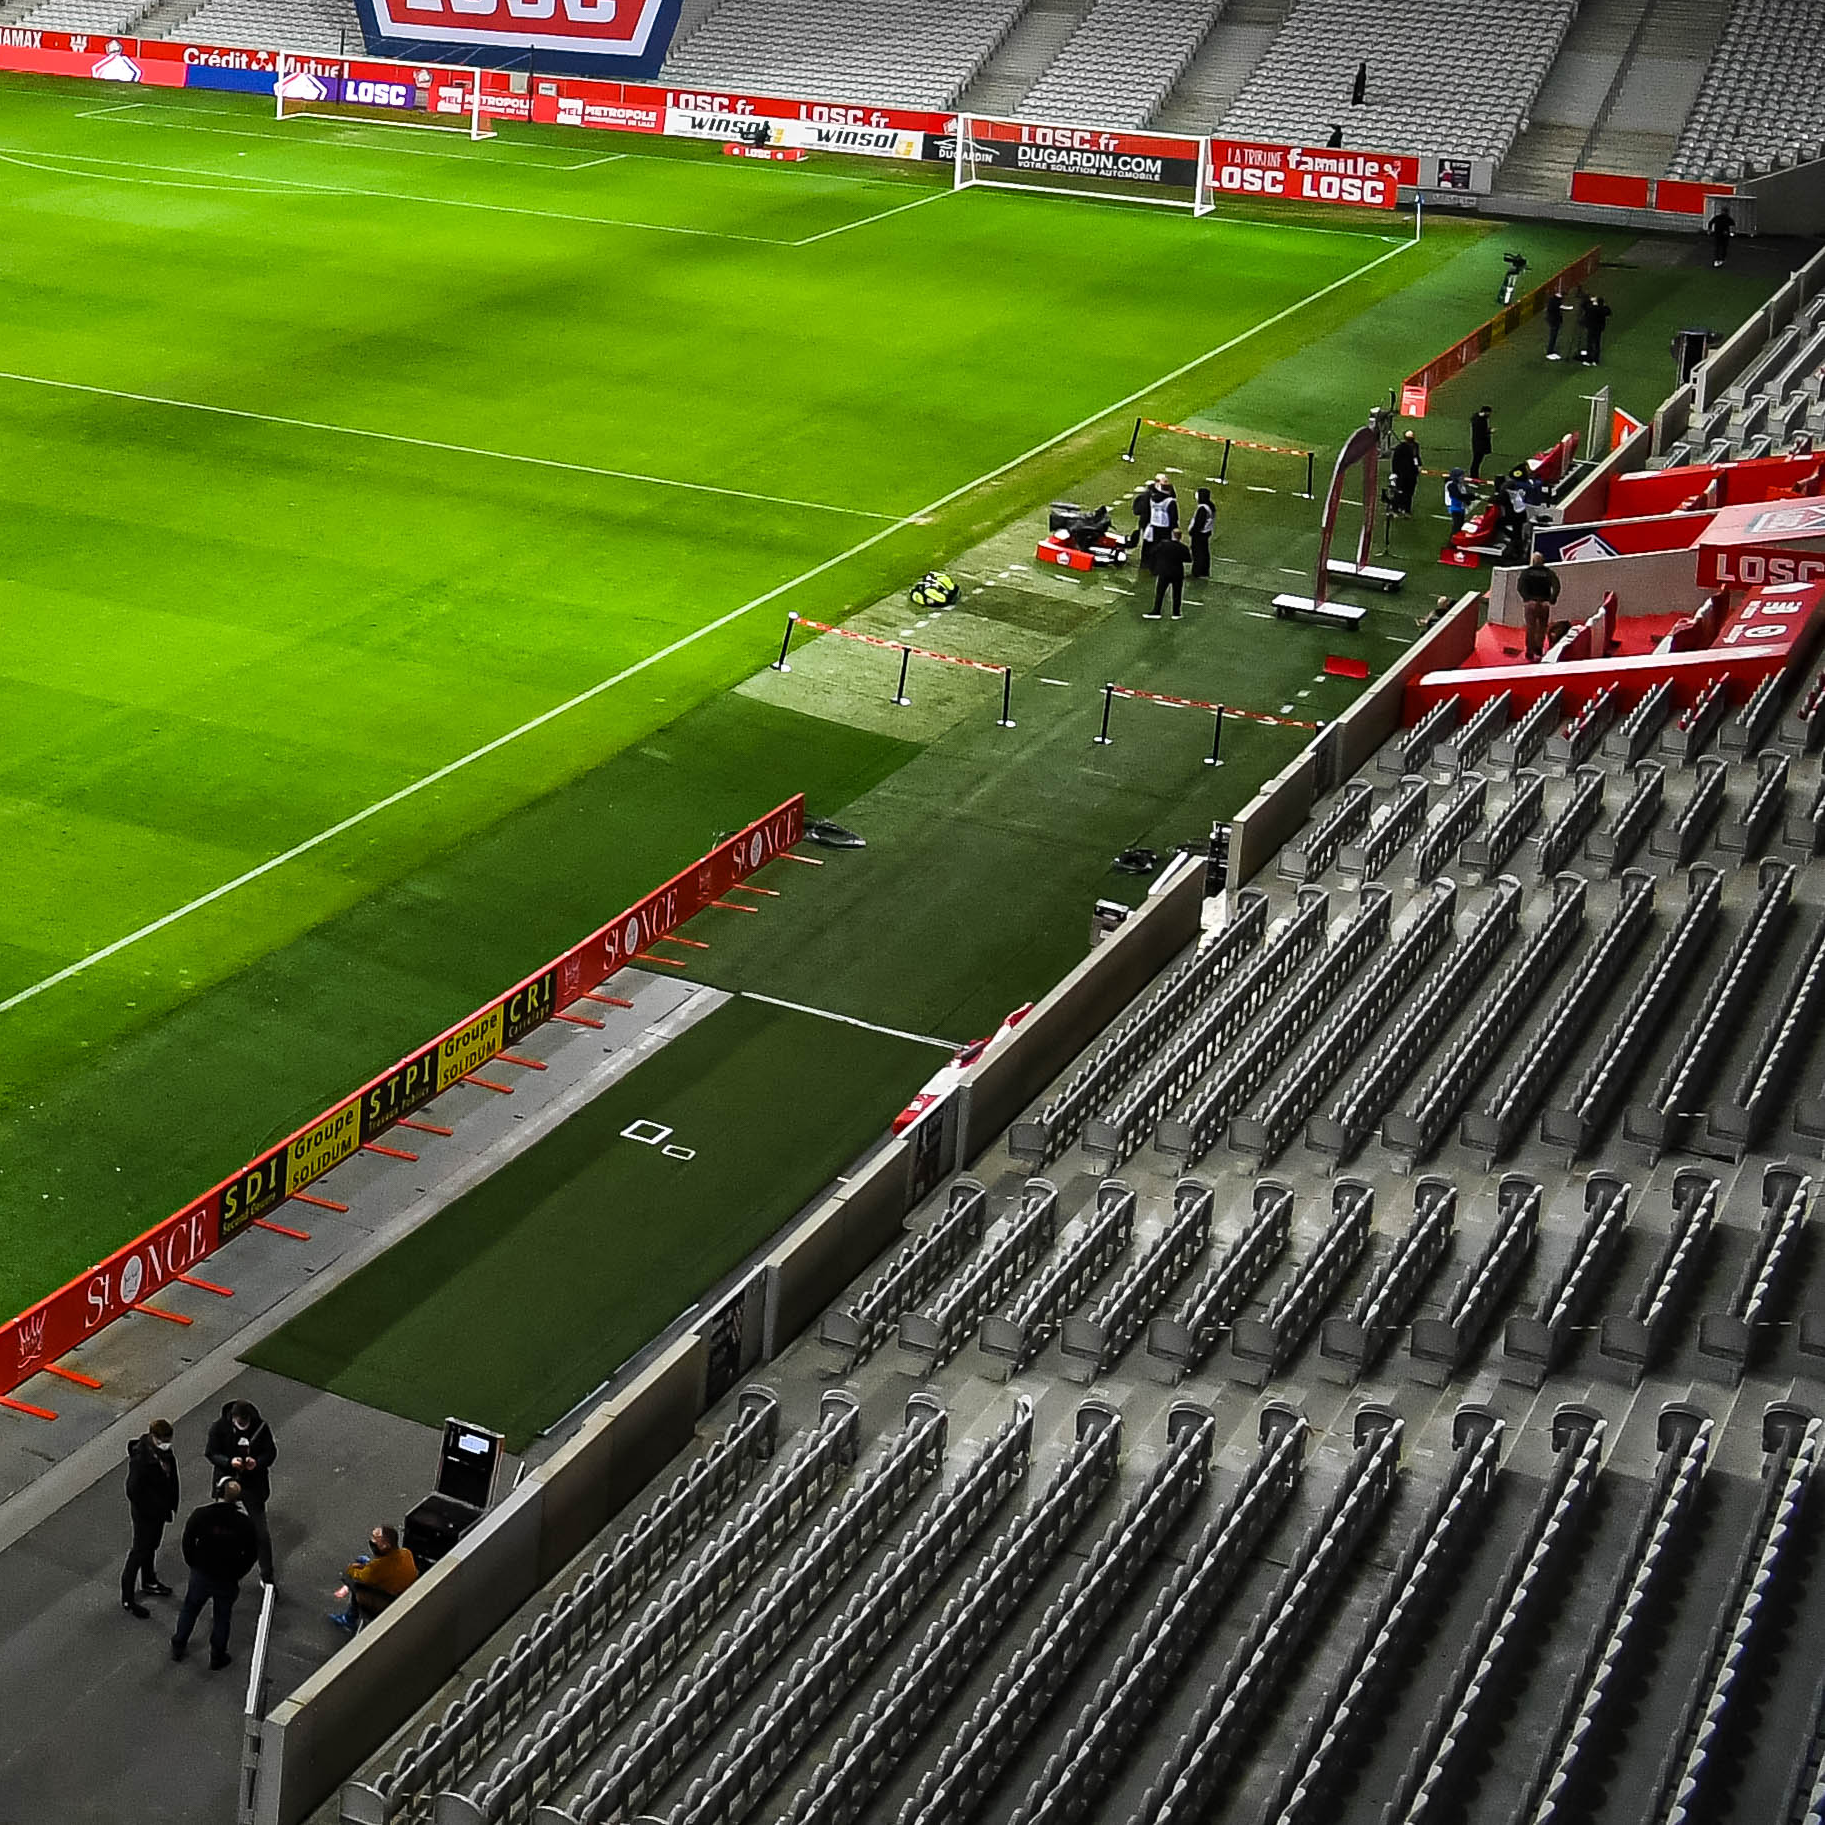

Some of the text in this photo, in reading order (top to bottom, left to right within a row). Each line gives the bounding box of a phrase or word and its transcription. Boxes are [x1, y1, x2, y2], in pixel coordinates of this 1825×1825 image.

[183, 47, 248, 69] Crédit
[346, 81, 406, 105] LOSC
[745, 148, 771, 159] LOSC
[817, 129, 898, 149] winsol
[1020, 126, 1118, 152] LOSC.fr
[1018, 146, 1162, 174] DUGARDIN.COM
[1051, 164, 1097, 175] SOLUTION
[1100, 168, 1160, 181] AUTOMOBILE
[1288, 148, 1378, 177] famille
[1206, 164, 1285, 193] LOSC
[1303, 175, 1384, 204] LOSC
[1716, 553, 1825, 585] LOSC
[509, 973, 551, 1022] CRI
[444, 1013, 497, 1057] Groupe
[443, 1038, 496, 1085] SOLIDUM
[369, 1055, 431, 1119] STPI
[293, 1108, 353, 1160] Groupe
[292, 1136, 352, 1187] SOLIDUM
[224, 1158, 278, 1220] SDI
